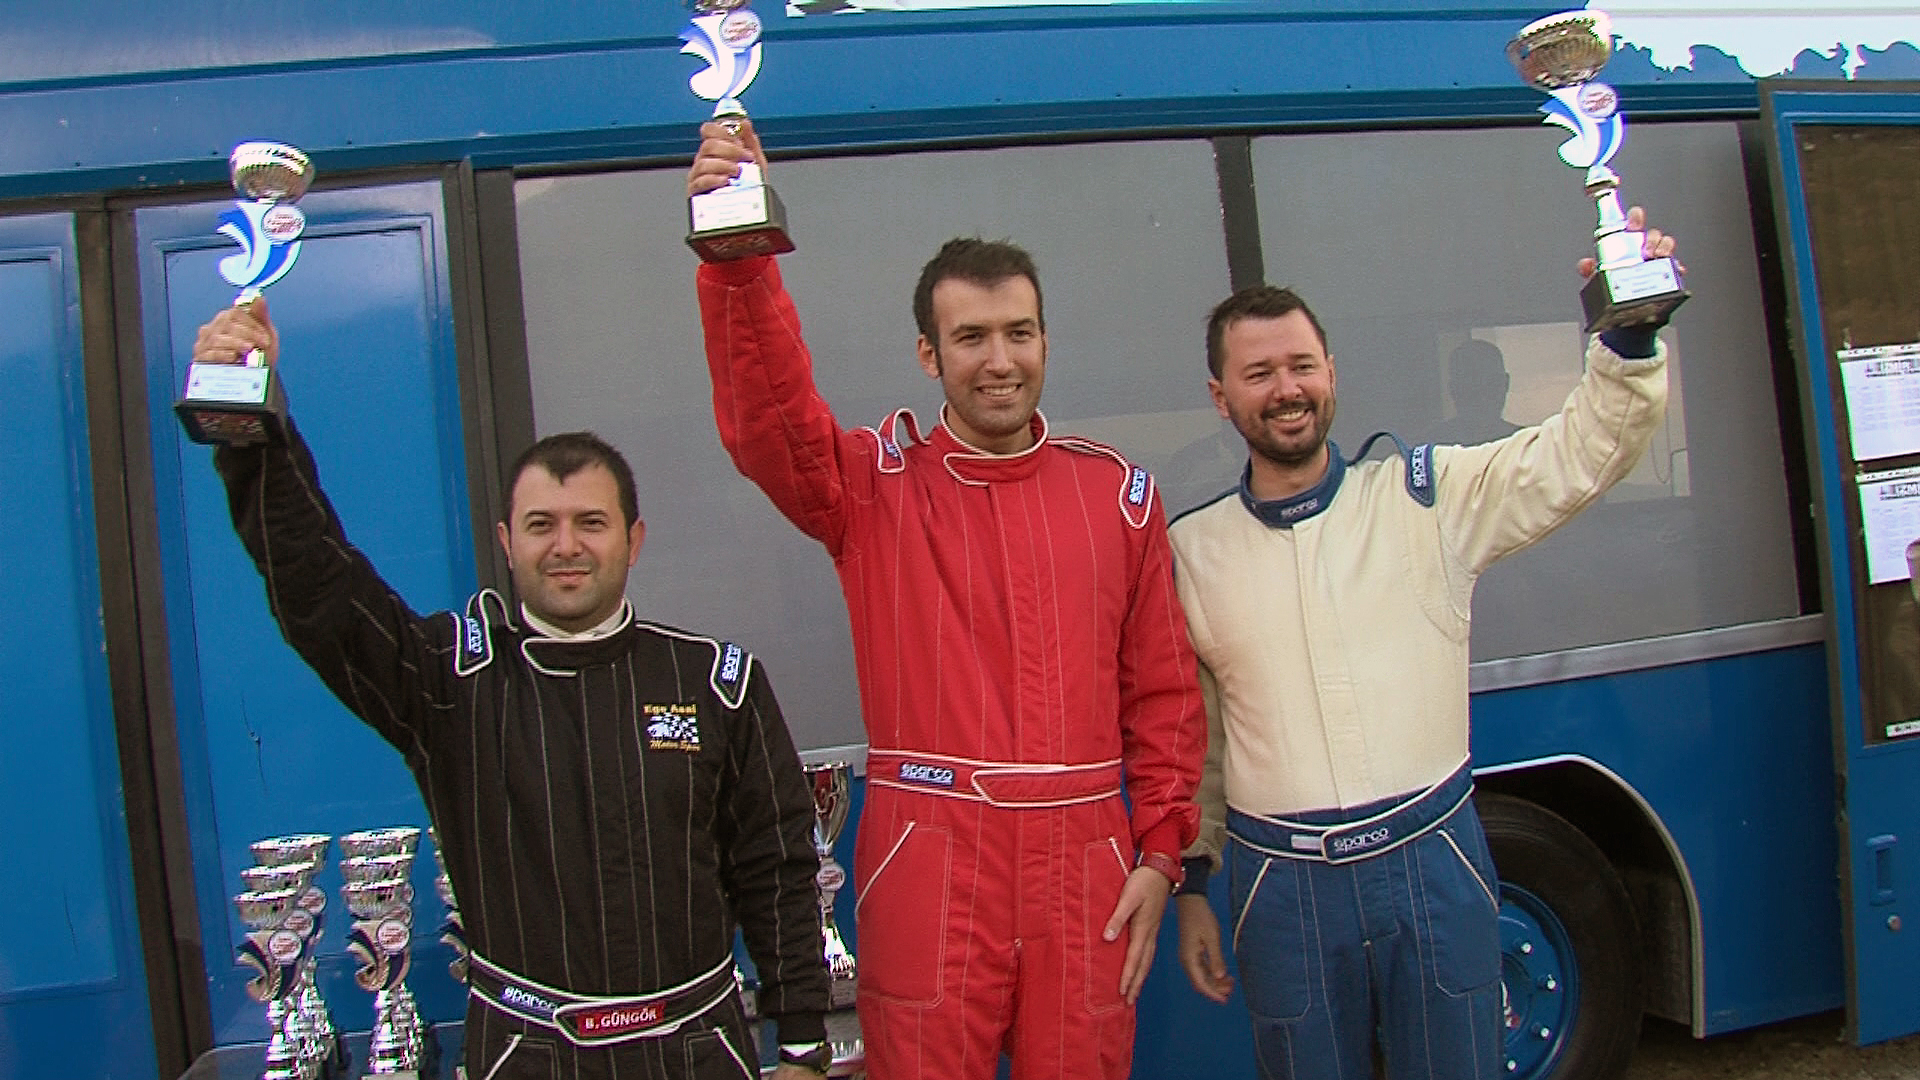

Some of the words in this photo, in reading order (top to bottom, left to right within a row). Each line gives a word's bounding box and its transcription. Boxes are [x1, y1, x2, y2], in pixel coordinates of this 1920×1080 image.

[900, 763, 953, 784] sparco
[1333, 827, 1389, 852] sparco
[503, 986, 556, 1010] sparco
